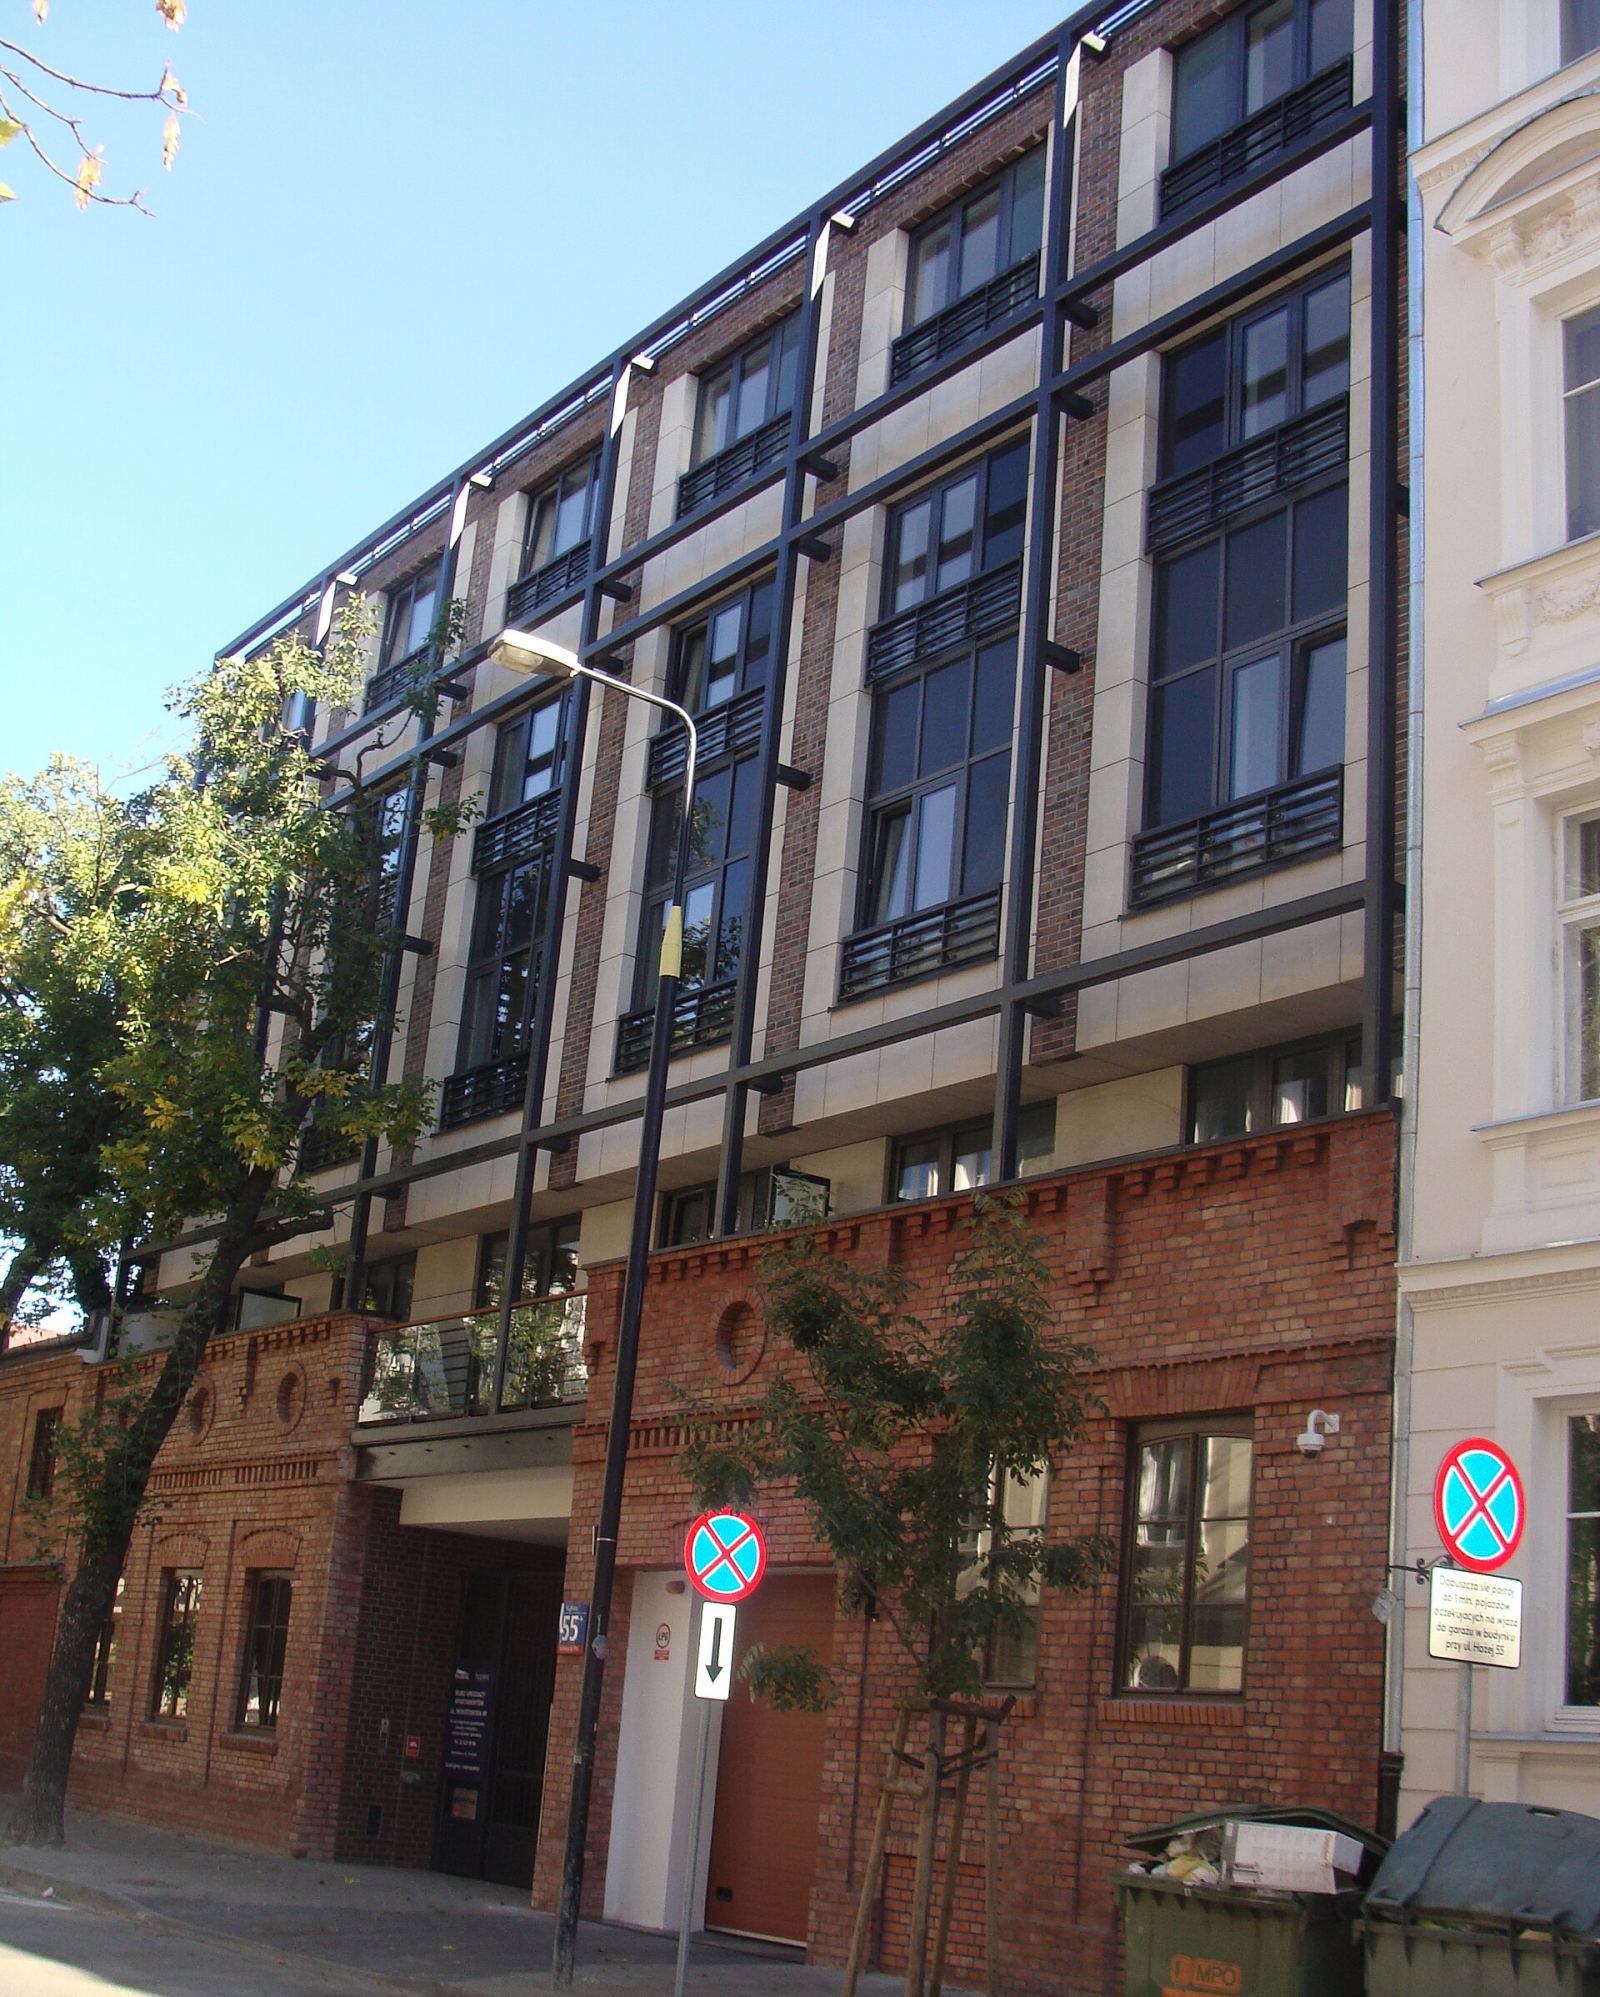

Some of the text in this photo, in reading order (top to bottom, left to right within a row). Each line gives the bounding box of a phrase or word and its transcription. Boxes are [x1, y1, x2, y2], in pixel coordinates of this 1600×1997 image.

[1440, 1575, 1479, 1591] Dopuszcza
[1442, 1593, 1452, 1601] do
[1475, 1597, 1510, 1610] pojazdów
[561, 1614, 579, 1642] 55
[1485, 1616, 1495, 1624] na
[1436, 1622, 1446, 1631] do
[1448, 1625, 1474, 1636] garażu
[1483, 1628, 1516, 1642] budynku
[1445, 1641, 1461, 1652] przy
[1463, 1641, 1471, 1652] ul.
[1495, 1645, 1504, 1655] 55
[1197, 1964, 1236, 1986] MPO
